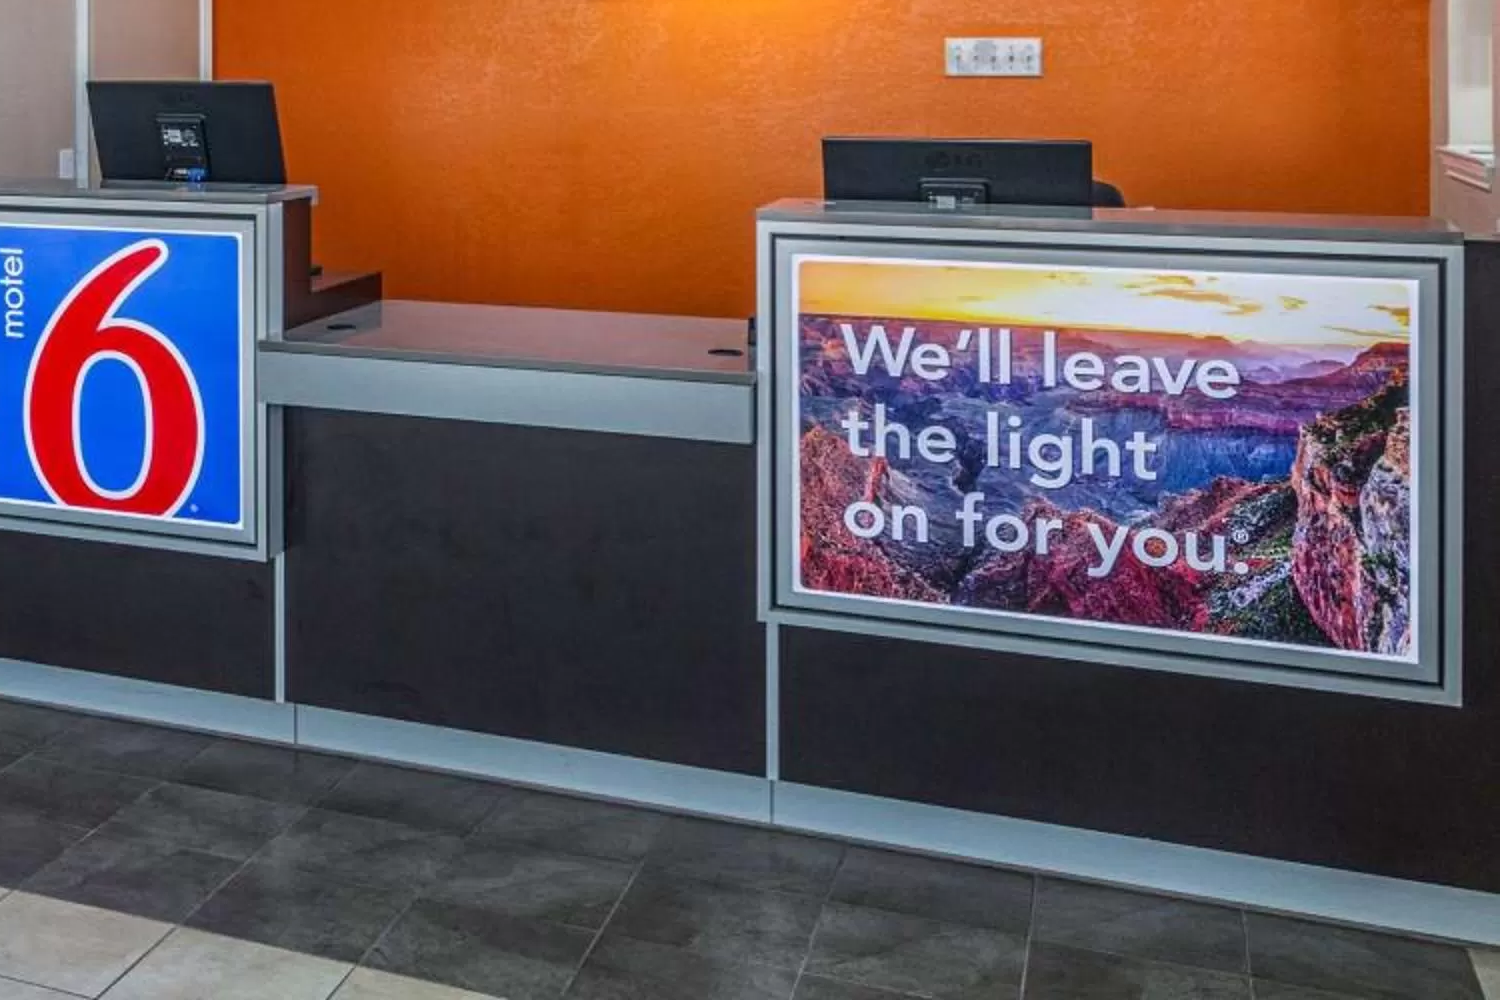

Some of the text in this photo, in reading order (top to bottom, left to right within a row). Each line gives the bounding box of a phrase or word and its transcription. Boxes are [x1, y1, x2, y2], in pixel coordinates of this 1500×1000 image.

[23, 238, 206, 518] 6
[840, 323, 1241, 399] We'll leave
[841, 403, 1157, 489] the light
[844, 501, 928, 543] on
[956, 491, 1063, 555] for
